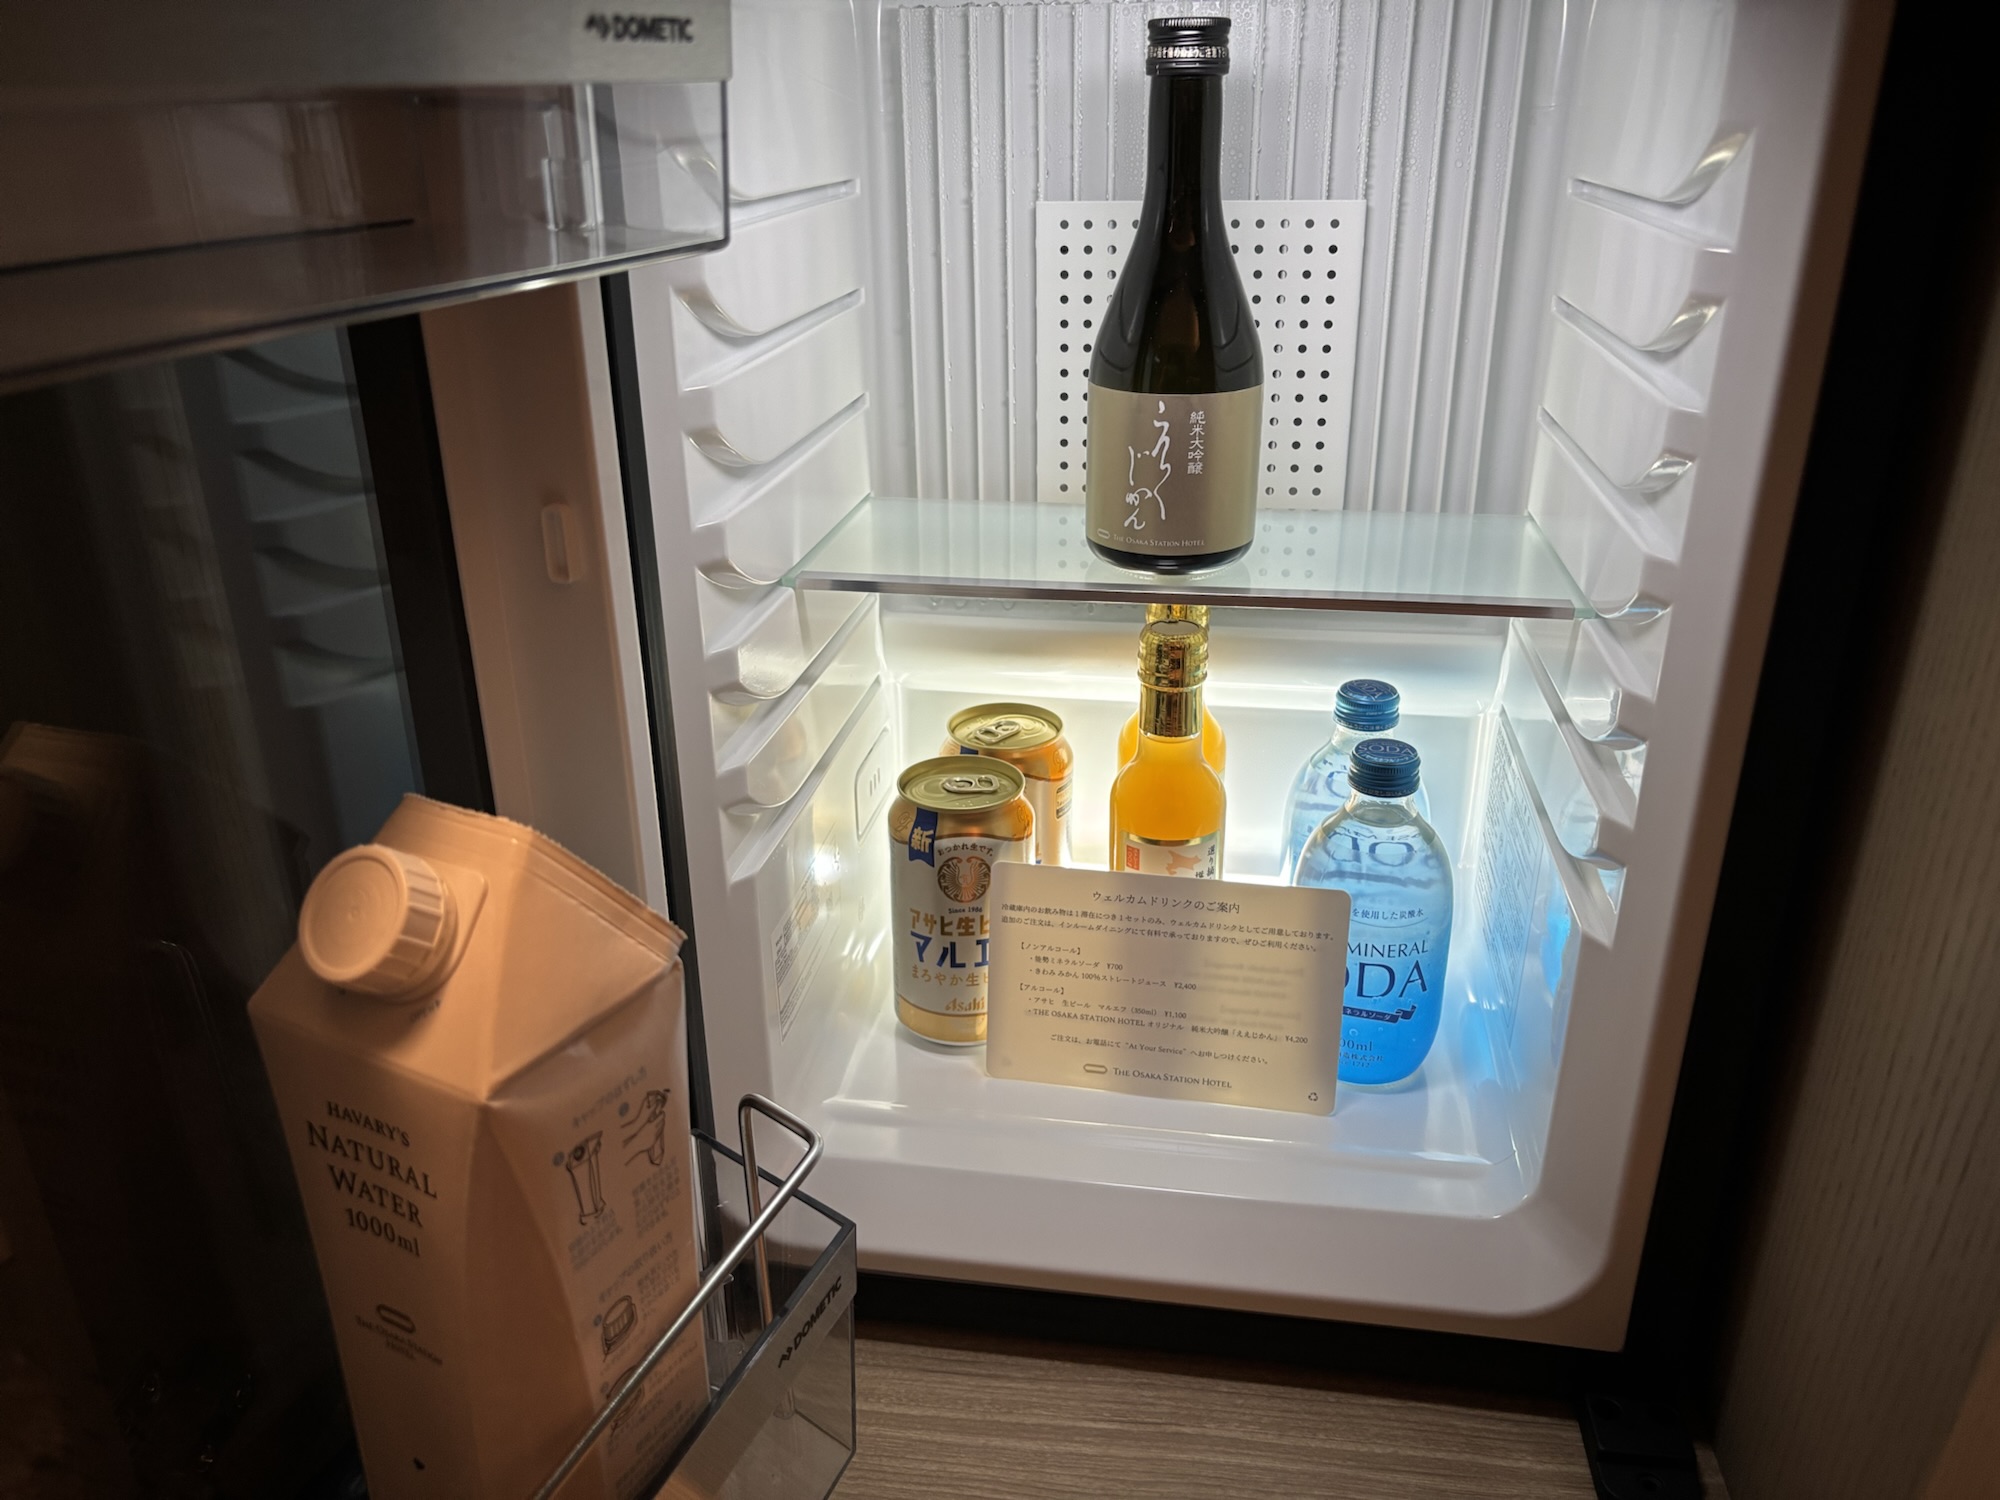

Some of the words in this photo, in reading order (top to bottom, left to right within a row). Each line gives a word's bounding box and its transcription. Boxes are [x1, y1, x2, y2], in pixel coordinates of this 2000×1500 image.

[612, 14, 693, 42] DOMETIC
[1186, 410, 1207, 475] 純米大吟醸
[1358, 744, 1414, 757] SODA
[911, 826, 934, 853] 新
[937, 842, 994, 857] おつかれ生です。
[948, 907, 965, 915] Since
[1092, 891, 1240, 914] ウェルカムドリンクのご案内
[1352, 907, 1424, 920] を使用した炭酸水
[1021, 942, 1081, 955] 【ノンアルコール】
[1347, 939, 1429, 958] MINERAL
[1106, 963, 1123, 971] ¥700
[1019, 982, 1065, 995] 【アルコール】
[1174, 982, 1197, 991] ¥2,400
[1344, 959, 1427, 998] DA
[944, 996, 985, 1012] Asahi
[1062, 999, 1091, 1009] 生ビール
[1164, 1010, 1187, 1019] ¥1,100
[1051, 1010, 1078, 1020] OSAKA
[1080, 1013, 1116, 1024] STATION
[1117, 1018, 1146, 1027] HOTEL
[1148, 1021, 1185, 1031] オリジナル
[1285, 1036, 1309, 1044] ¥4,200
[1139, 1043, 1156, 1052] Your
[1113, 1067, 1130, 1077] THE
[1132, 1069, 1162, 1081] OSAKA
[1162, 1073, 1200, 1085] STATION
[1202, 1077, 1232, 1089] HOTEL
[306, 1119, 439, 1200] NATURAL
[326, 1162, 423, 1228] WATER
[345, 1207, 420, 1258] 1000ml
[793, 1275, 842, 1351] DOMETIC
